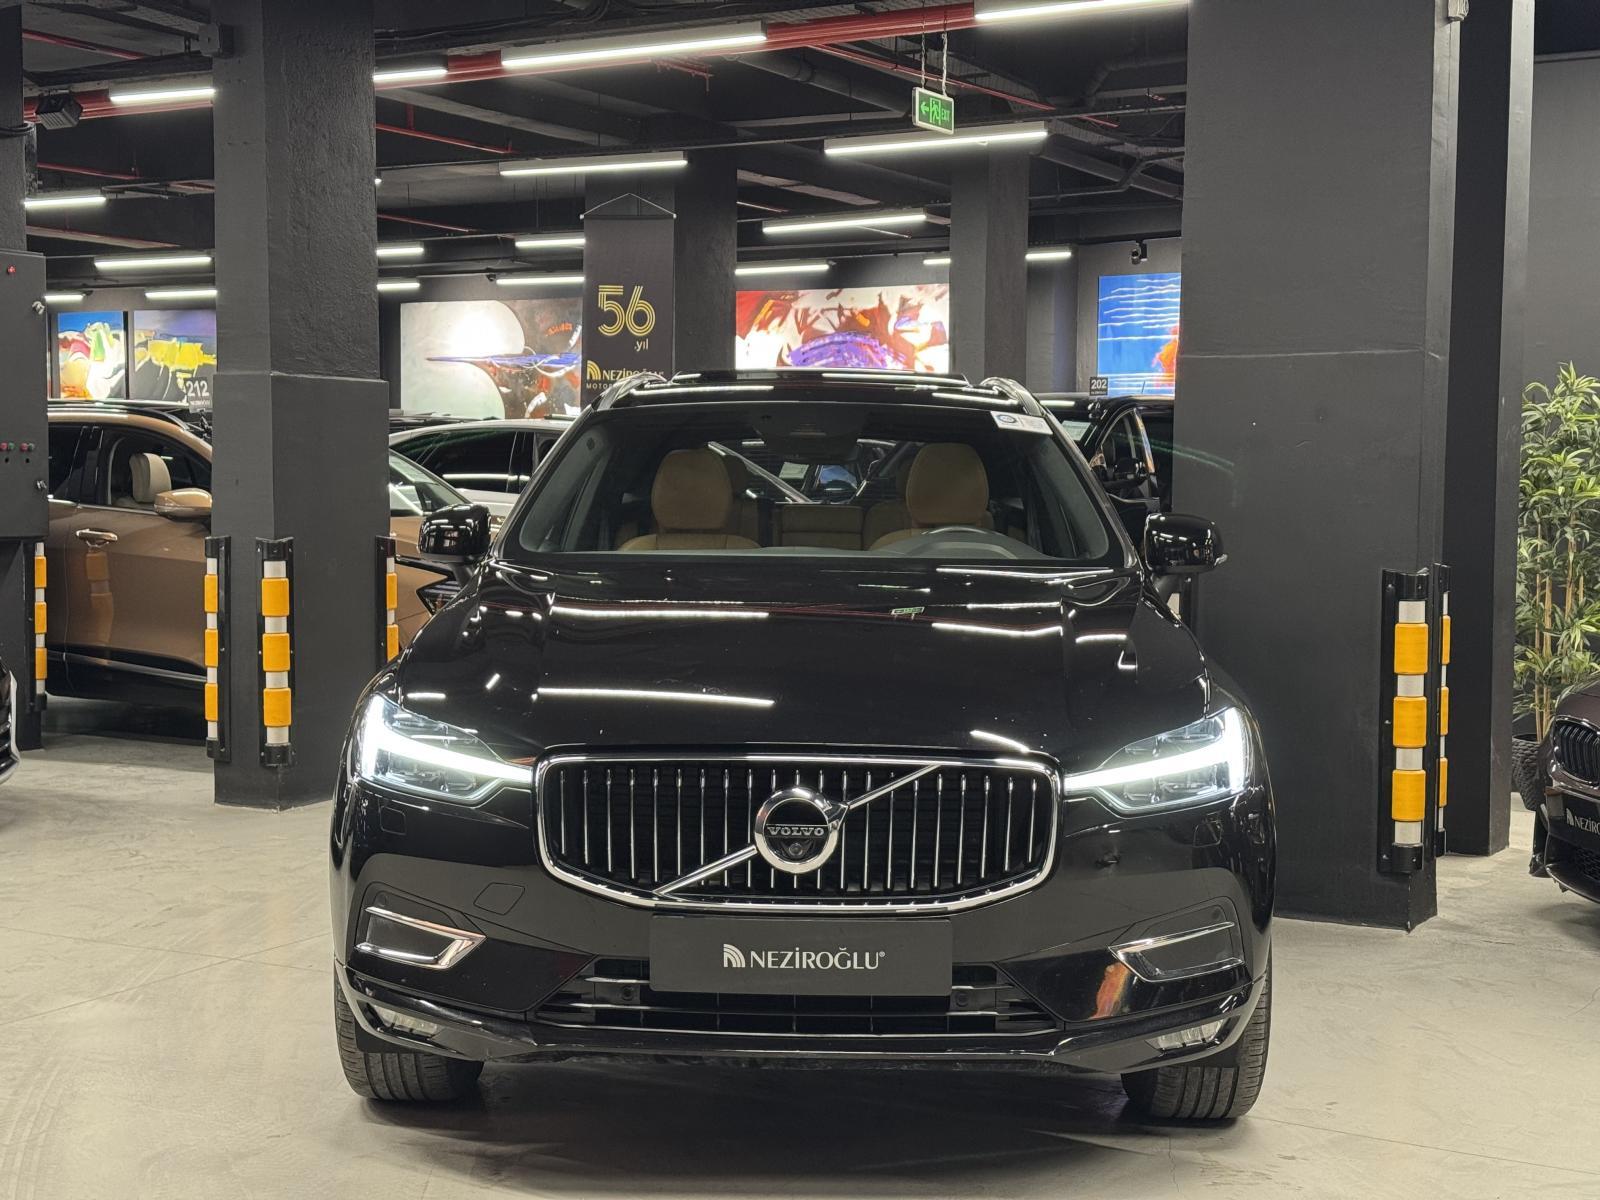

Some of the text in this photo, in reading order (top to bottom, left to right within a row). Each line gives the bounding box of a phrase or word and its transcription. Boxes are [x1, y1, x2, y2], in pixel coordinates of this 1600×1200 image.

[598, 285, 655, 336] 56
[186, 380, 210, 397] 212
[1091, 379, 1107, 390] 202
[767, 826, 824, 836] VOLVO
